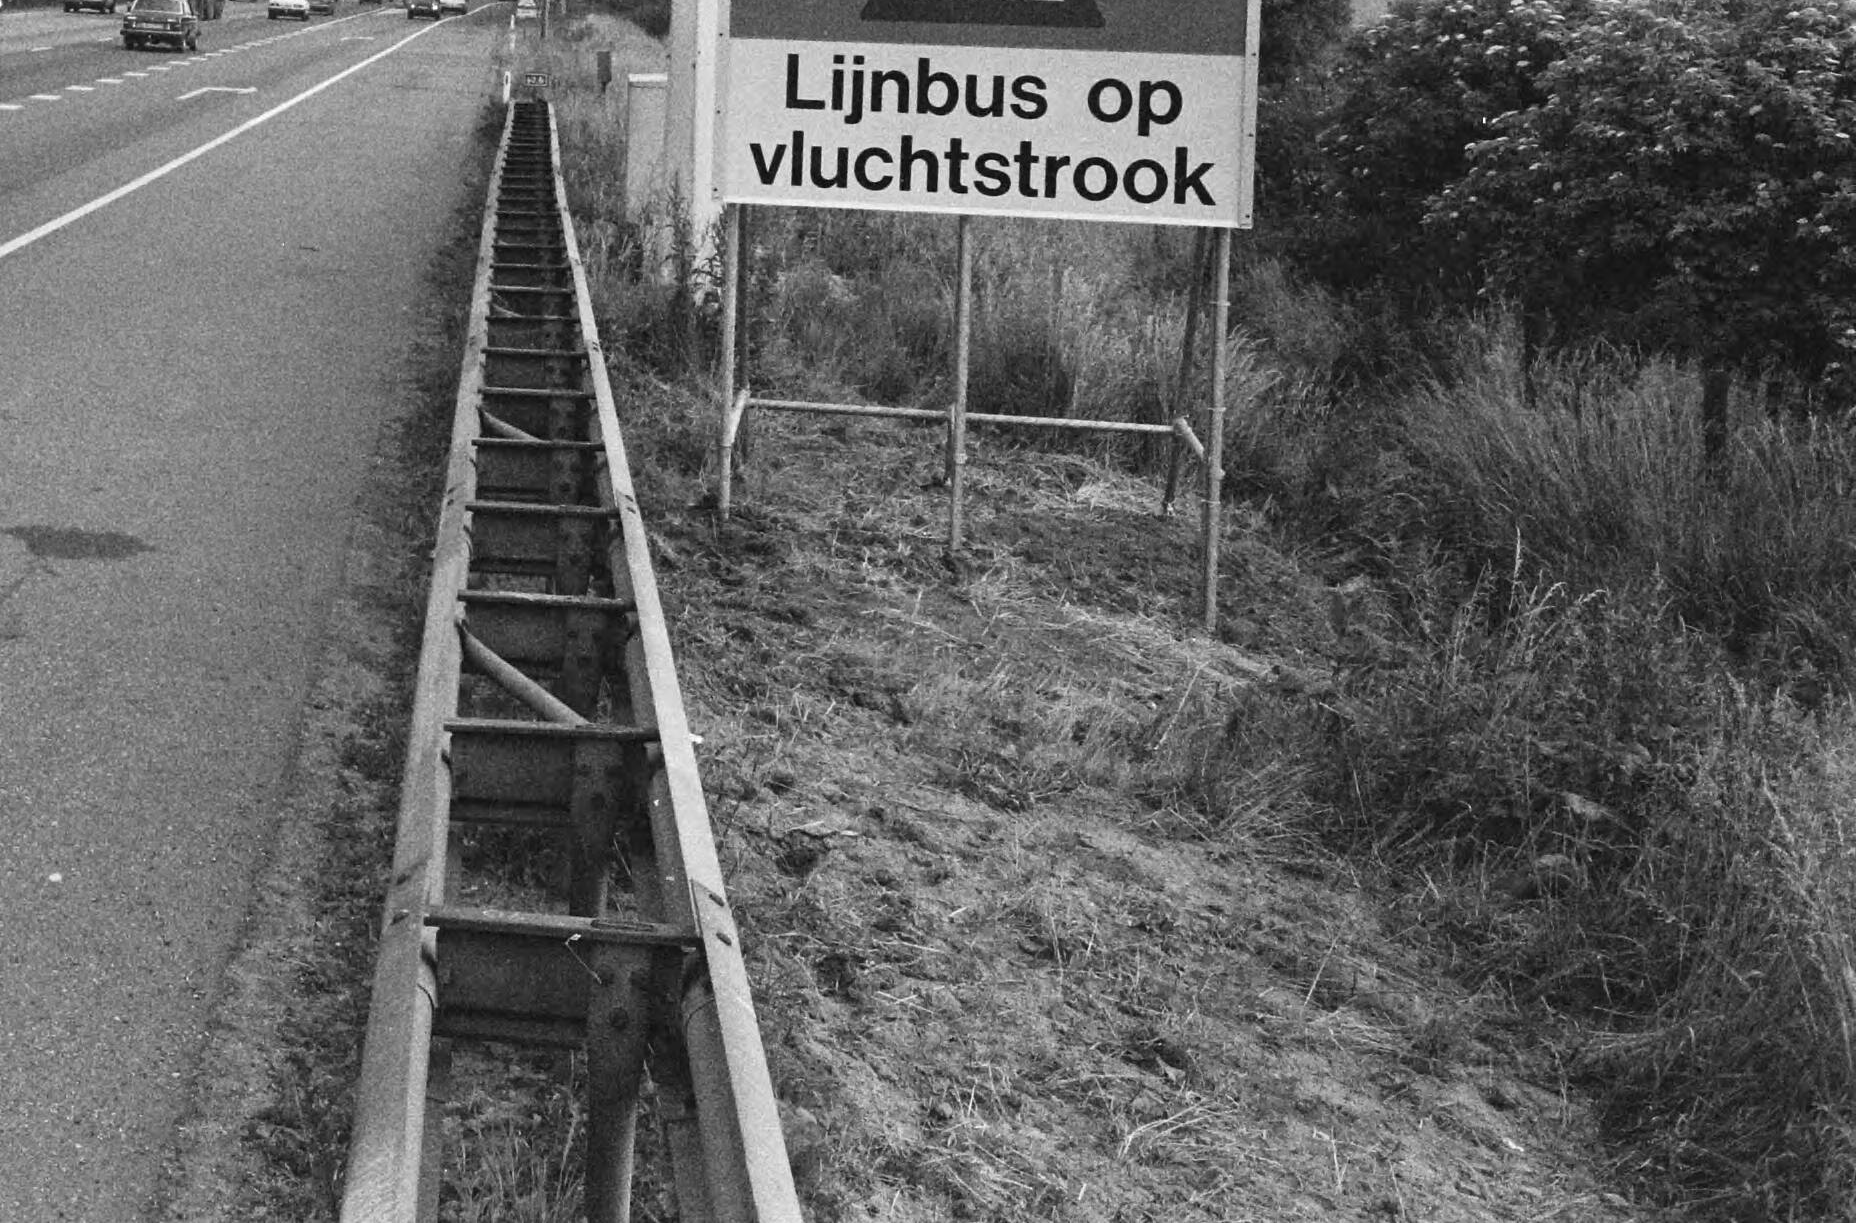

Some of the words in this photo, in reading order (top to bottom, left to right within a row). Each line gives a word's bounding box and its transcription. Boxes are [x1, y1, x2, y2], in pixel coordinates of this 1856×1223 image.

[785, 53, 1049, 125] Lijnbus
[1086, 78, 1184, 137] op
[748, 130, 1217, 208] vluchtstrook
